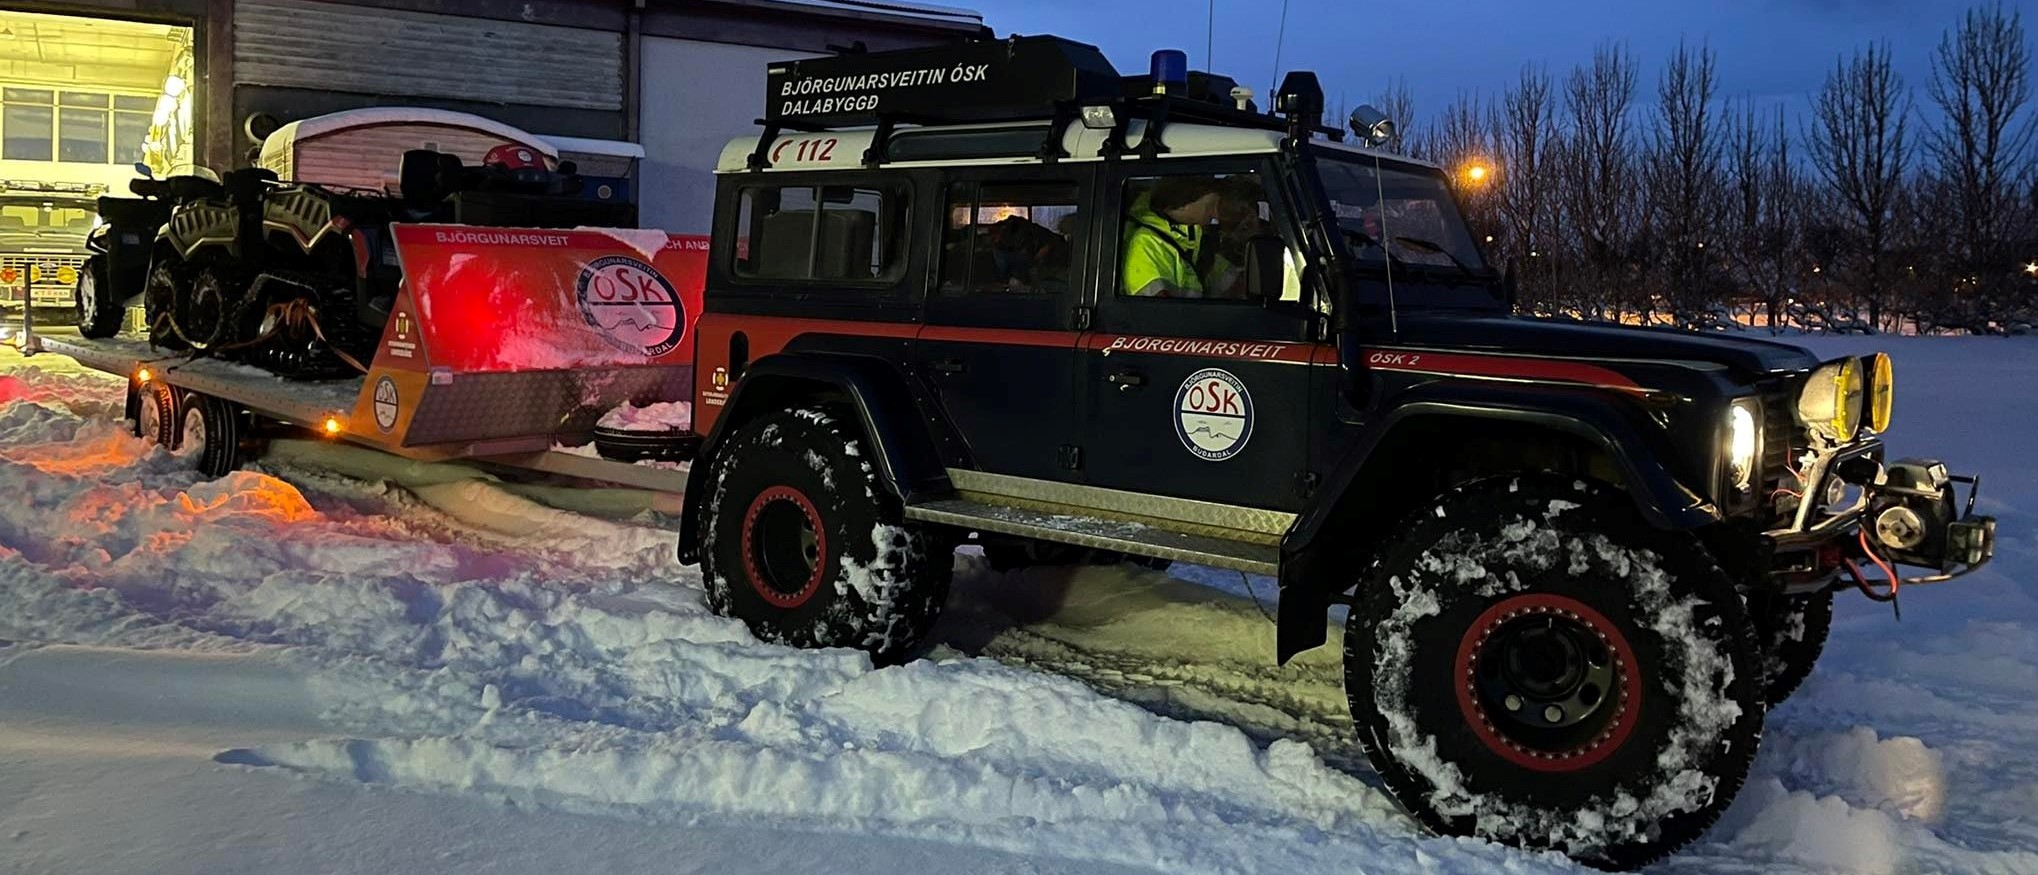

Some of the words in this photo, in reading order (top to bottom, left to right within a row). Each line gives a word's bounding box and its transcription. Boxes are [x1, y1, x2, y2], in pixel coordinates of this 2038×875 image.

[781, 68, 945, 96] BJÖRGUNARSVEITIN
[950, 62, 989, 83] ÓSK
[781, 95, 879, 116] DALABYGGÐ
[796, 138, 838, 162] 112
[435, 230, 569, 246] BJÖRGUNARSVEIT
[1111, 336, 1287, 358] BJÖRGUNARSVEIT
[1408, 355, 1421, 366] 2
